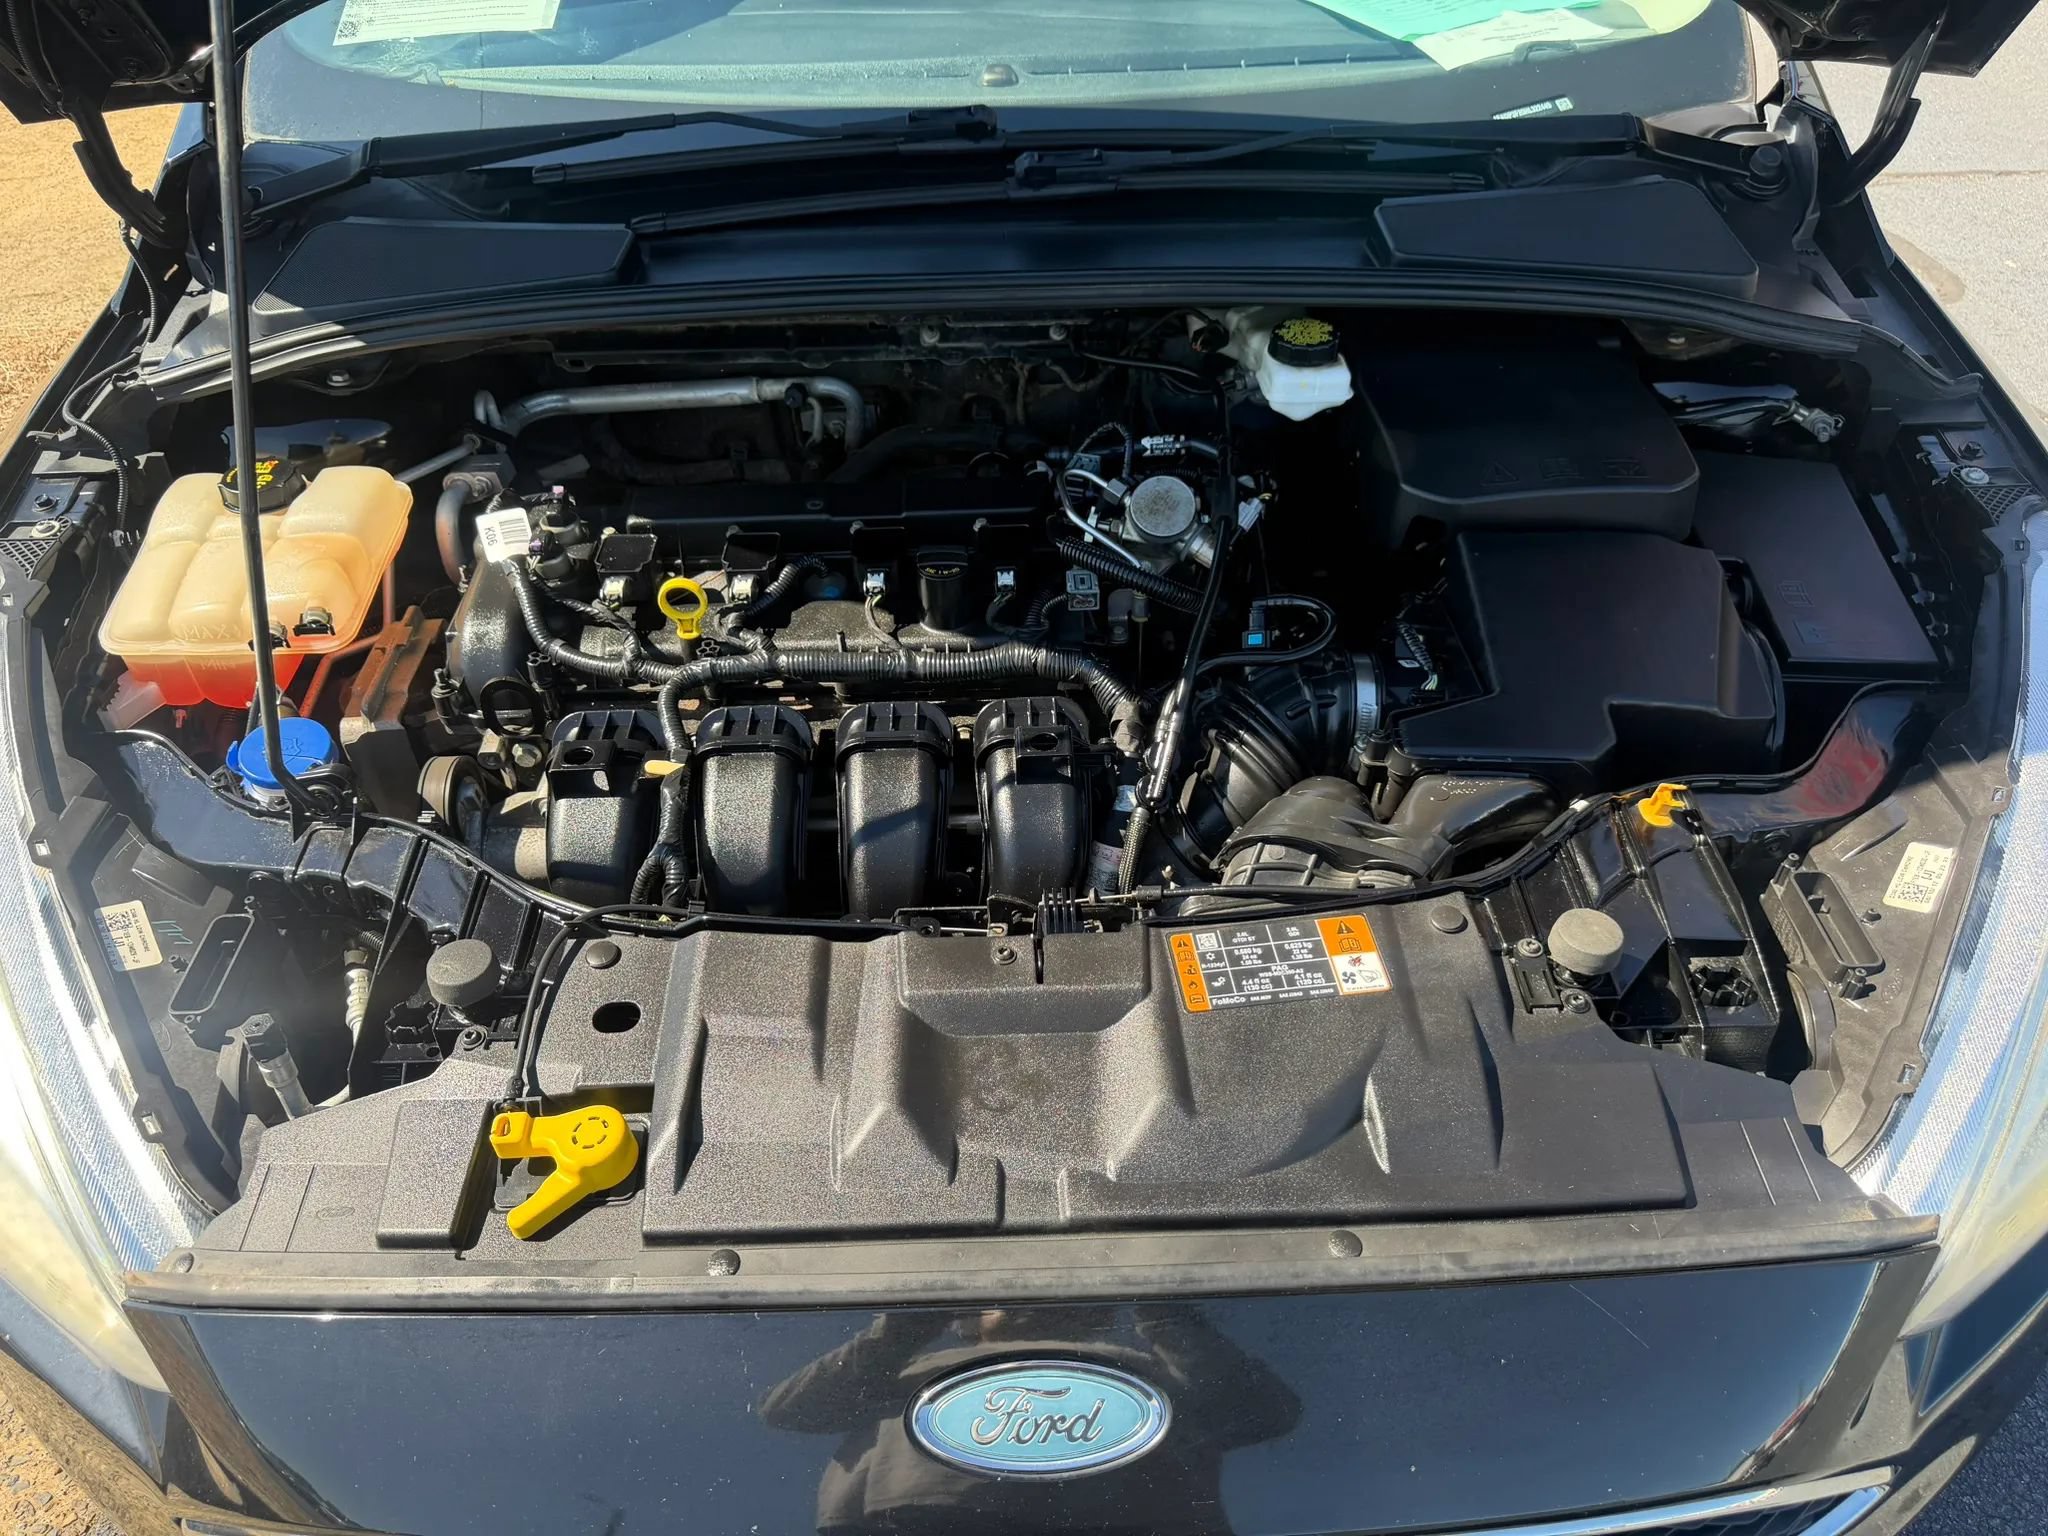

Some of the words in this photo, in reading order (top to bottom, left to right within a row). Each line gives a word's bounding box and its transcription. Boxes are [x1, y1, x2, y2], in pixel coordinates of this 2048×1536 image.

[483, 526, 498, 546] K06
[1212, 996, 1246, 1006] FoMoCo
[970, 1386, 1105, 1446] Ford
